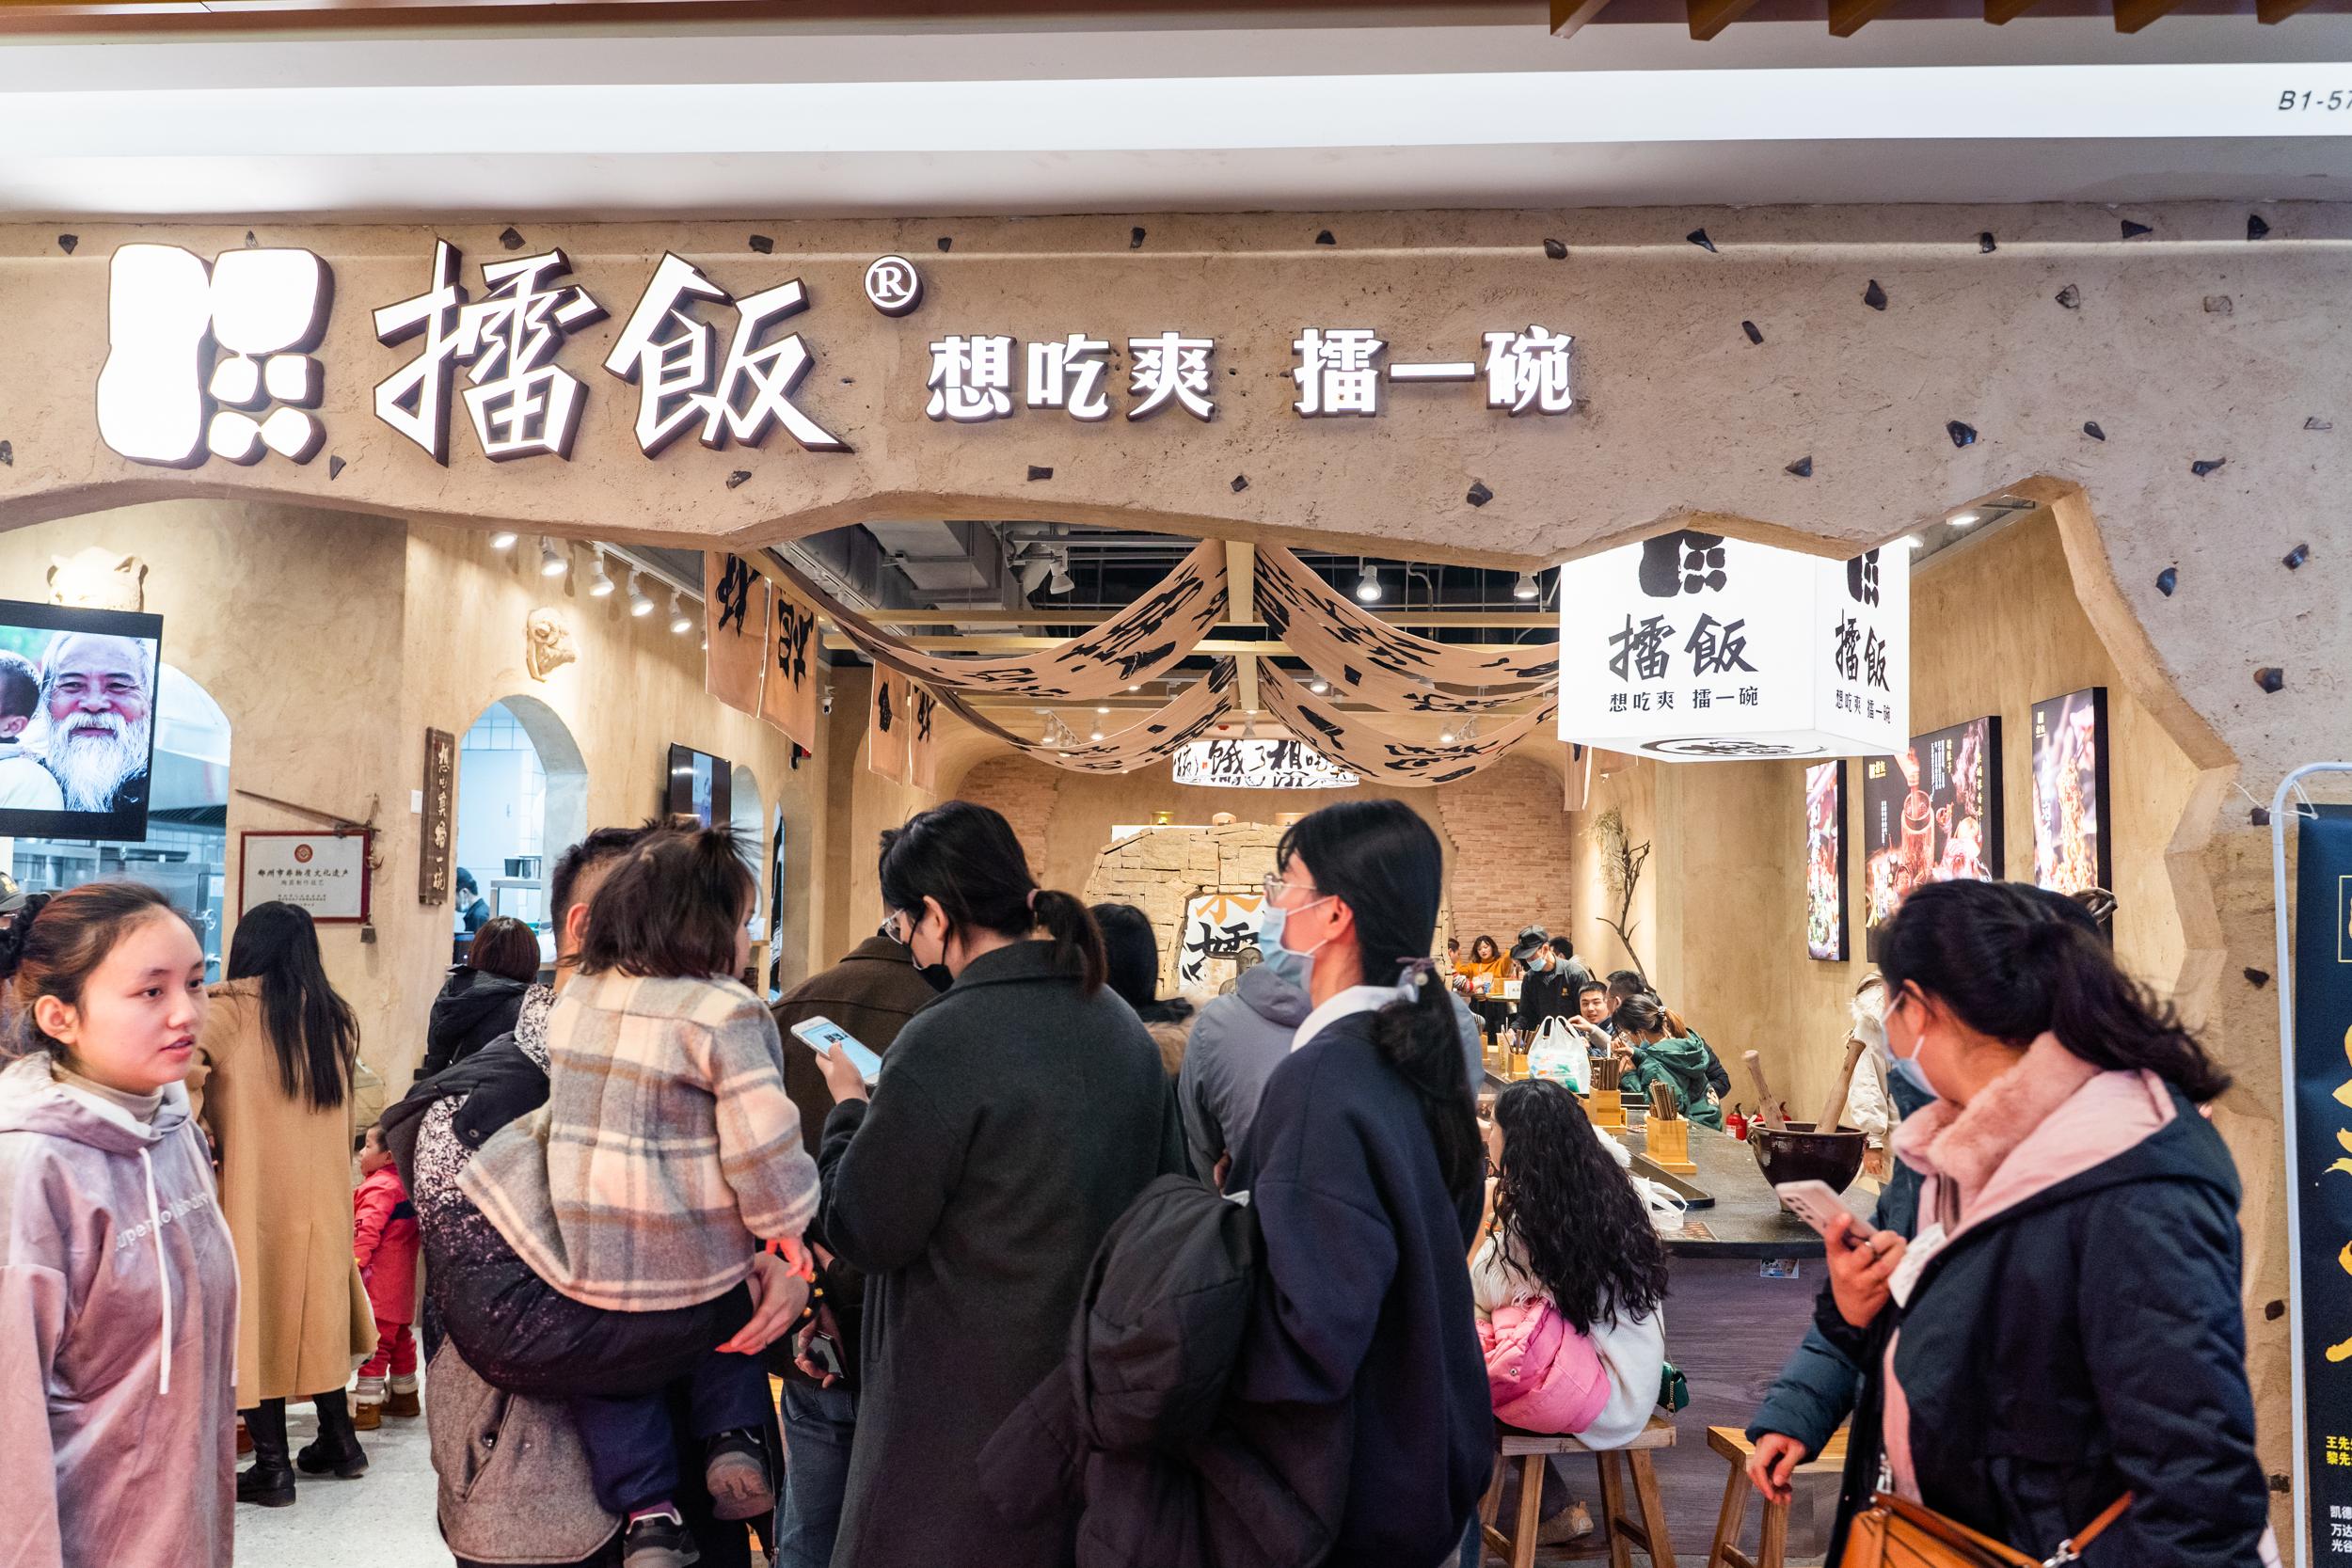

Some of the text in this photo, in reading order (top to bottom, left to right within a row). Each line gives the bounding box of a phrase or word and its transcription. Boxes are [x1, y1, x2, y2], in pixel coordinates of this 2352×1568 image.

[373, 239, 854, 467] 擂飯
[926, 324, 1576, 422] 想吃爽 擂一碗
[1608, 612, 1759, 683] 擂飯
[1835, 608, 1890, 692] 擂飯
[1609, 686, 1758, 713] 想吃爽 擂一碗
[2326, 1435, 2352, 1450] 王先
[2326, 1450, 2352, 1466] 黎先
